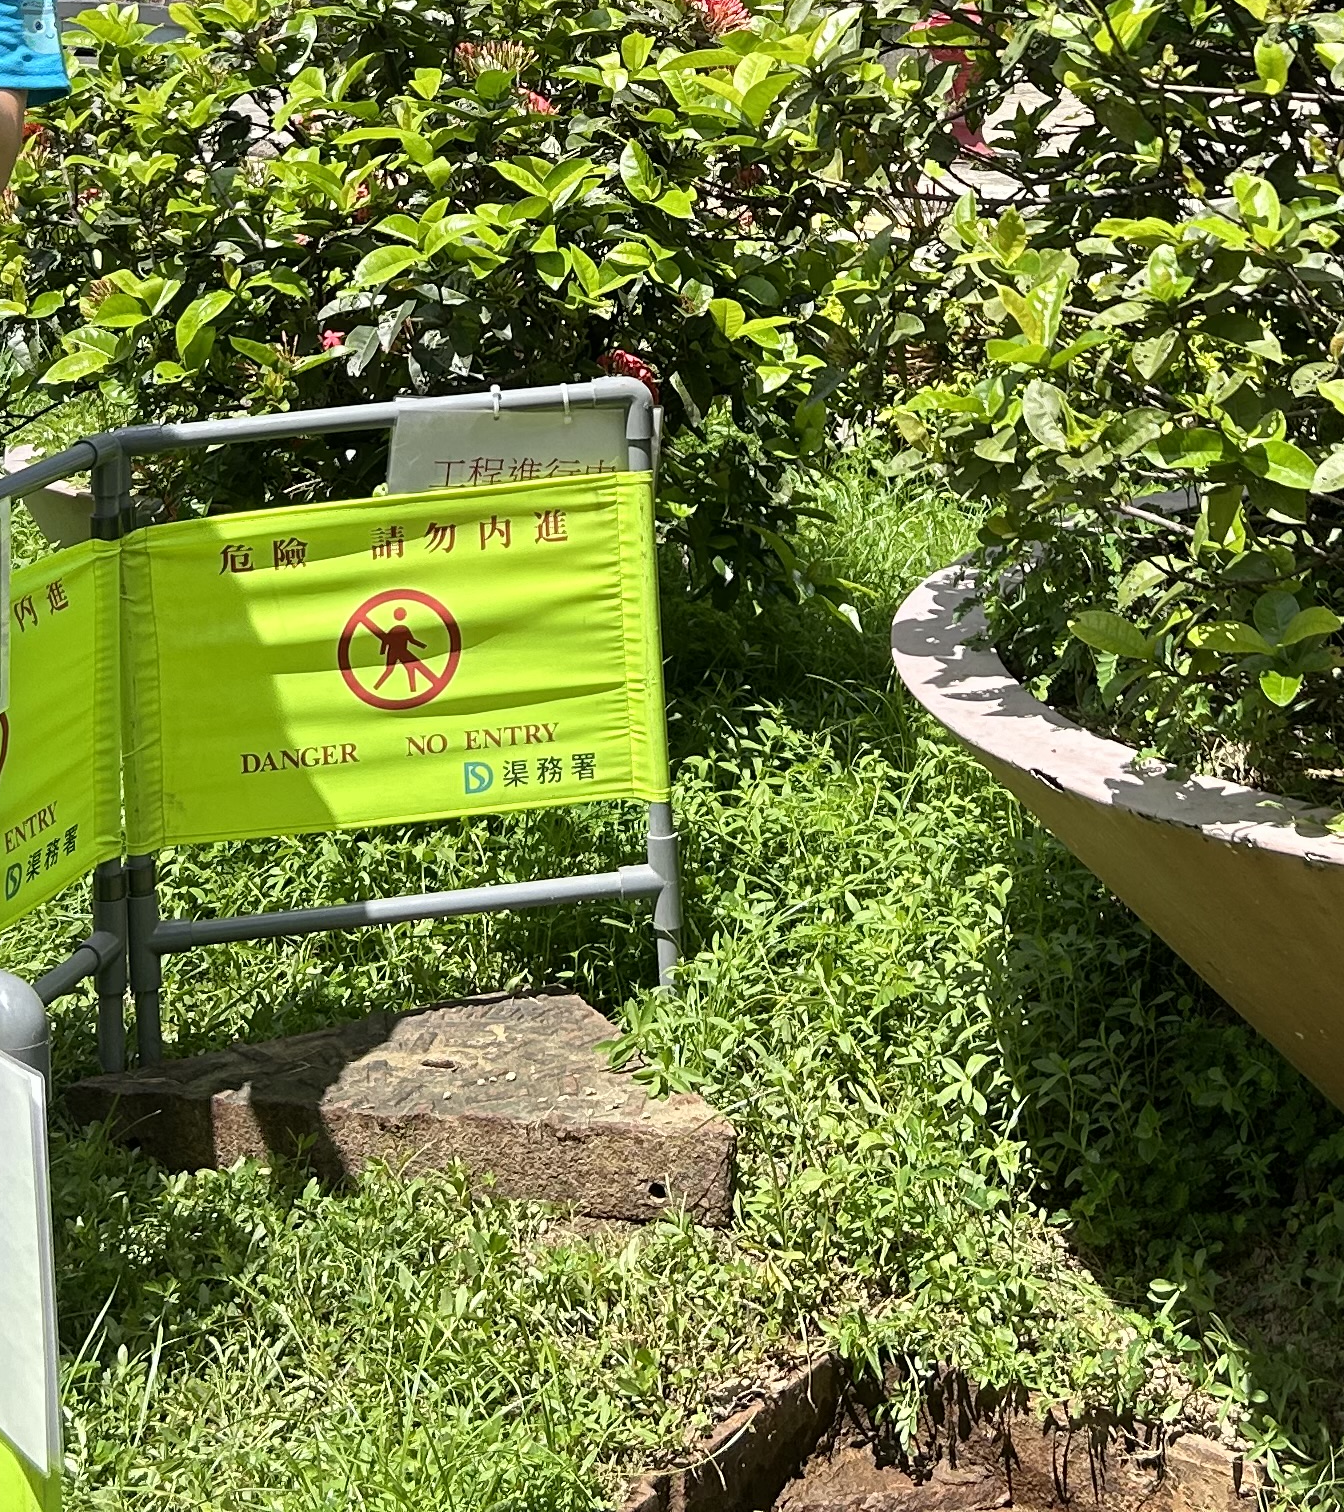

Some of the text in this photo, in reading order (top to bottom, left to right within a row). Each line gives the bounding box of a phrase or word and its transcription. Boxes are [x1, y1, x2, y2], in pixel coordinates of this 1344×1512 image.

[218, 536, 309, 576] 危險
[240, 720, 560, 776] DANGER NO ENTRY
[502, 750, 598, 788] 渠務署
[5, 800, 59, 855] ENTRY
[26, 822, 79, 884] 渠務署
